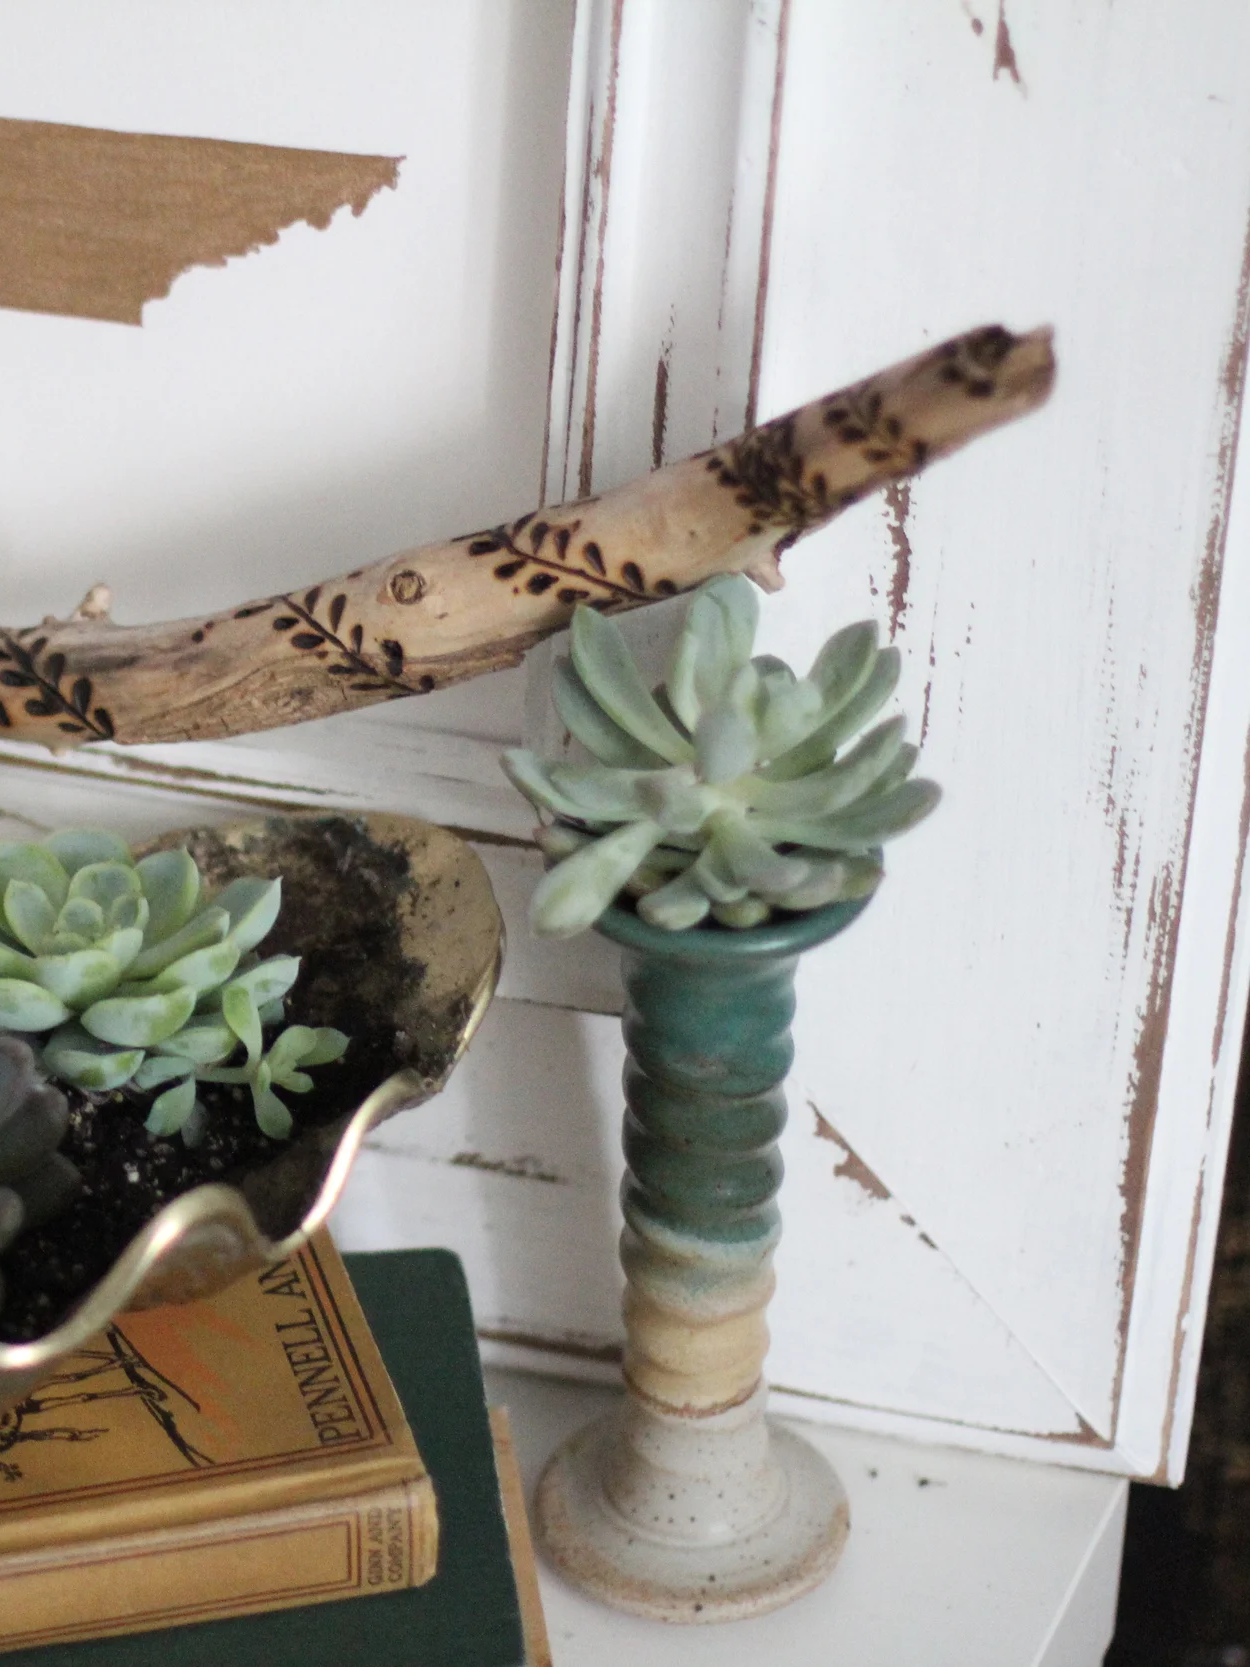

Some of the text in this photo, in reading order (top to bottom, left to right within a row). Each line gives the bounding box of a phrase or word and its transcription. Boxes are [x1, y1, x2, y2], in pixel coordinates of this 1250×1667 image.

[258, 1259, 363, 1445] PENNELL AN
[387, 1507, 403, 1583] COMPANY
